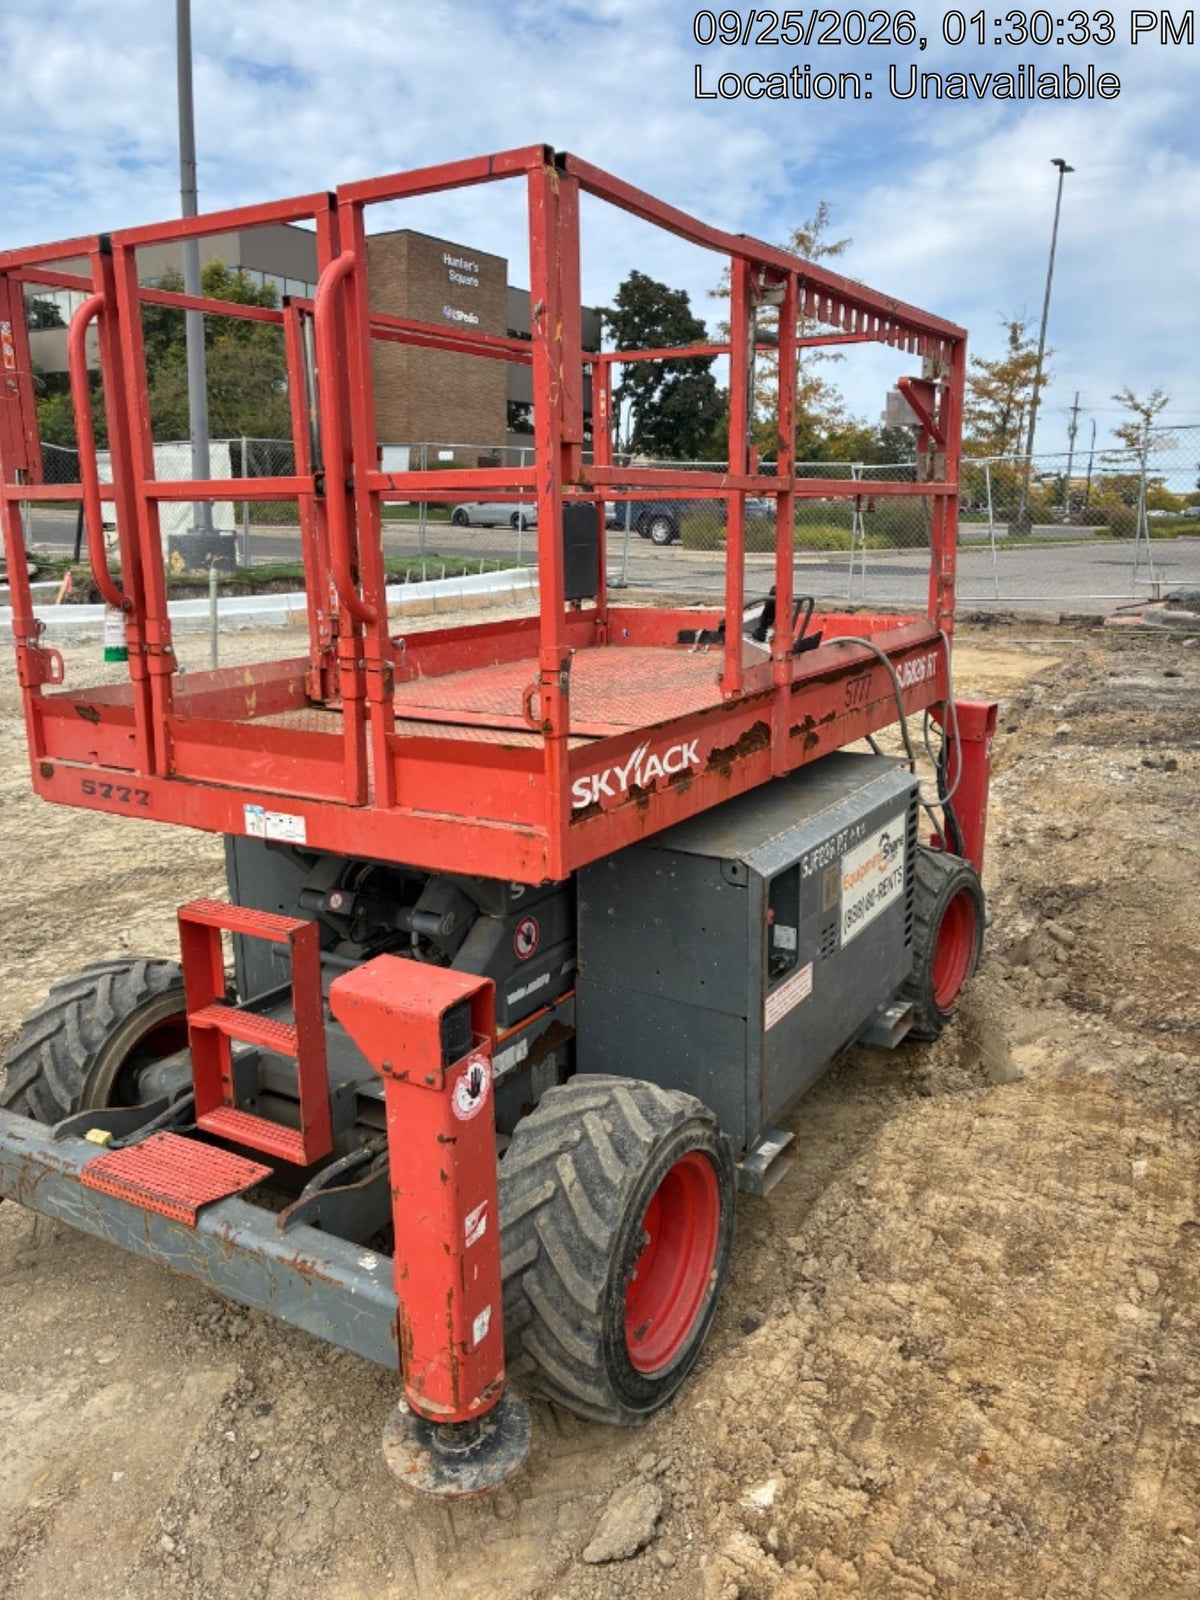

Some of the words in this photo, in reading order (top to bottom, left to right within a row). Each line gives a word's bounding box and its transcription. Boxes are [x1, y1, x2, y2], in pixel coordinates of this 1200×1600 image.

[443, 252, 479, 272] Hunter's
[449, 269, 479, 287] Square
[844, 673, 873, 708] 5777
[572, 739, 700, 809] SKYJACK
[81, 779, 150, 807] 5777
